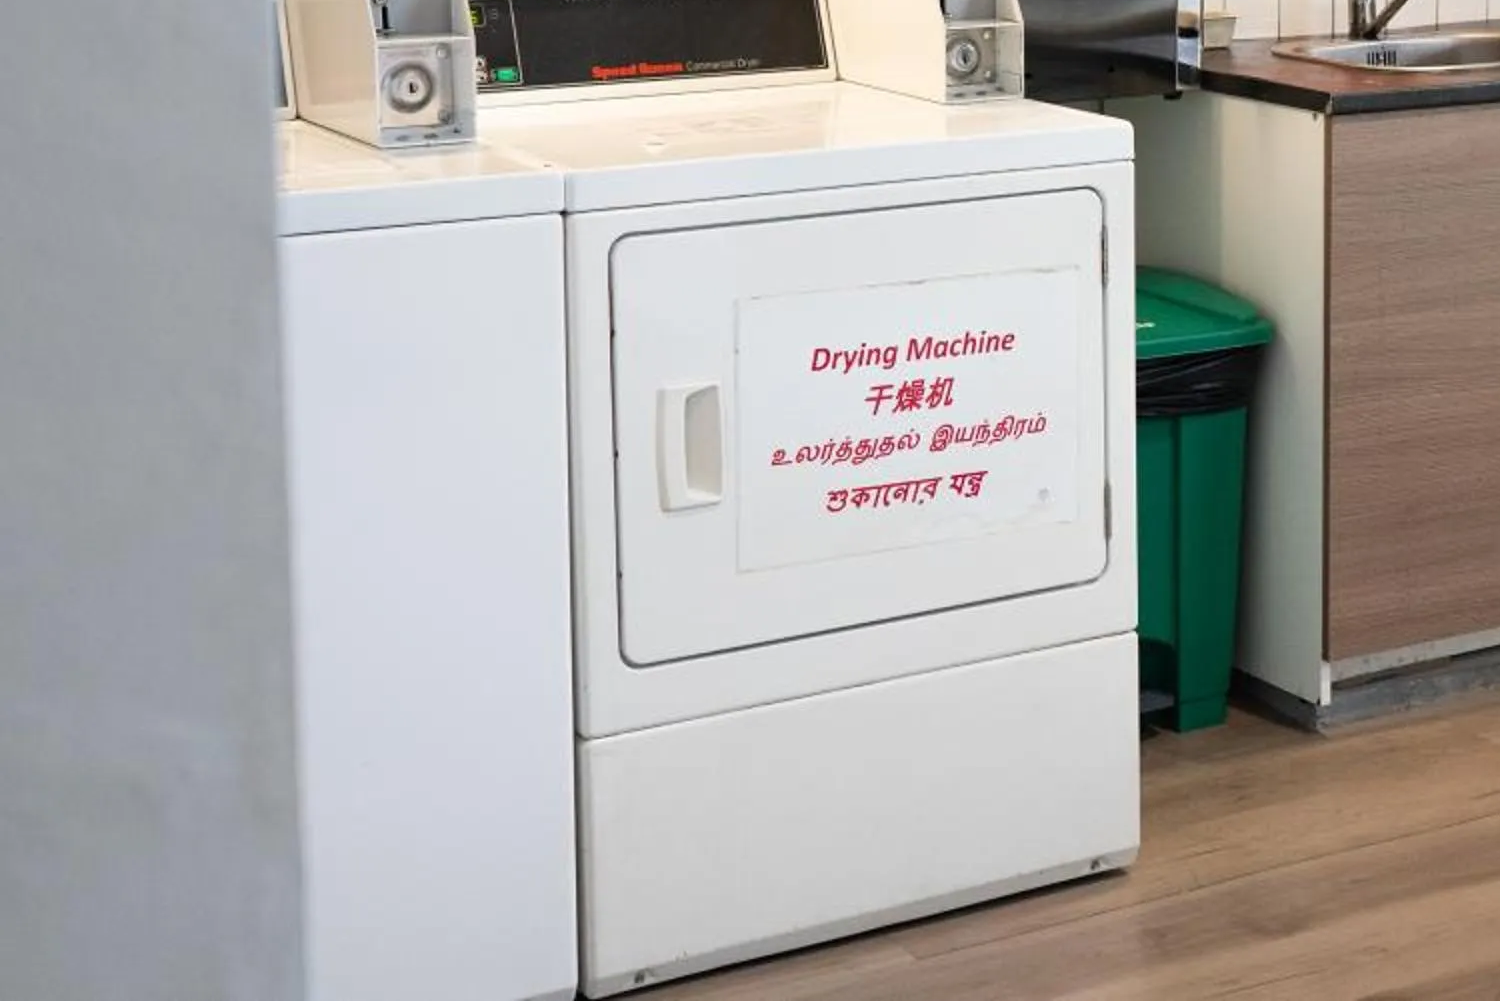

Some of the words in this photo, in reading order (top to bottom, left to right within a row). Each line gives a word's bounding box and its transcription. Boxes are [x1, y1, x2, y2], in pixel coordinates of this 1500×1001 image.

[811, 343, 898, 375] Drying
[906, 330, 1015, 362] Machine
[865, 376, 955, 415] 干燥机
[771, 428, 921, 466] உலர்த்துதல்
[929, 412, 1047, 452] இயந்திரம்
[825, 476, 943, 513] শুকানোর
[949, 470, 989, 498] যন্ত্র
